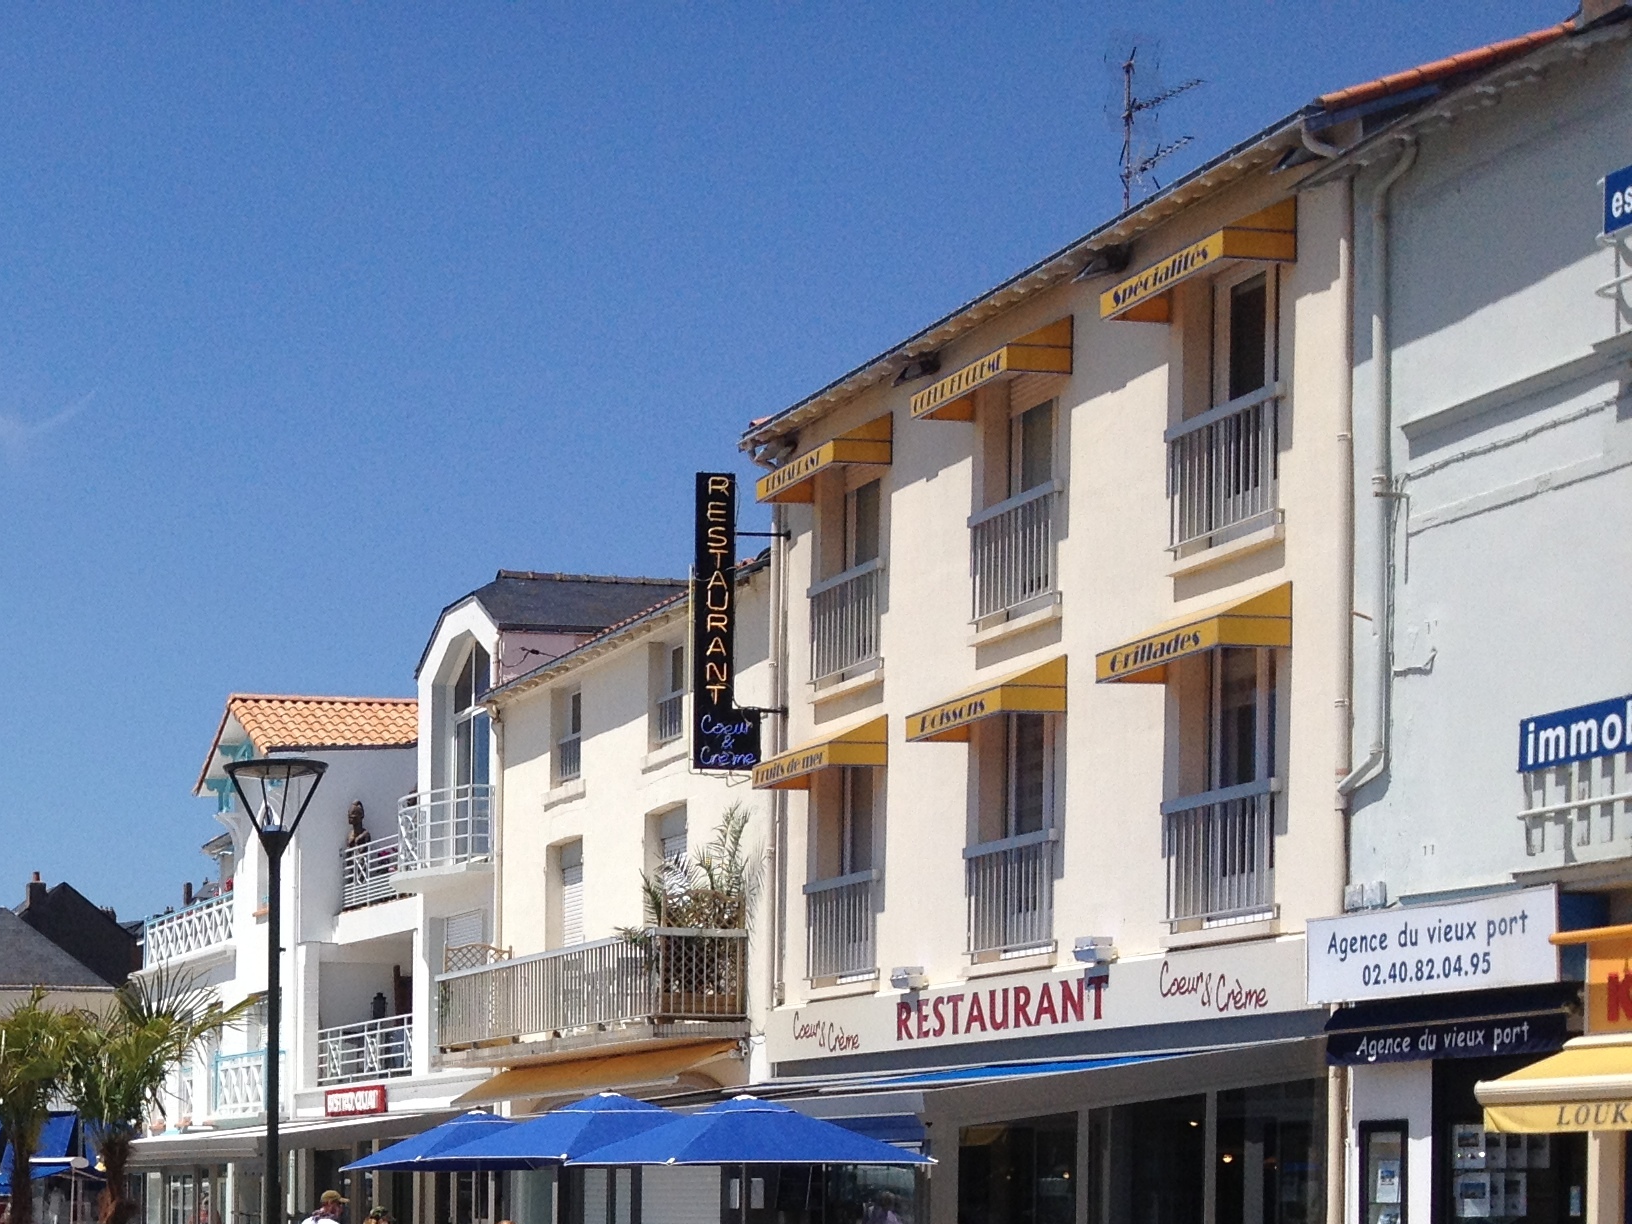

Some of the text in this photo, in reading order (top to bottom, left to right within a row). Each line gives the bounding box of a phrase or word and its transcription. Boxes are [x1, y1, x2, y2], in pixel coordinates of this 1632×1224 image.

[1112, 244, 1208, 308] Spécialités
[705, 476, 729, 705] RESTAURANT
[1110, 630, 1201, 673] Grillades
[700, 714, 753, 735] Coeur
[920, 698, 986, 733] Poissons
[721, 734, 735, 749] &
[786, 757, 801, 774] de
[801, 751, 826, 769] mer
[1326, 910, 1528, 963] Agence du vieux port
[1159, 960, 1268, 1013] Coeur & Crème
[1362, 951, 1492, 987] 02.40.82.04.95
[896, 975, 1109, 1042] RESTAURANT
[792, 1010, 820, 1040] Coeur
[827, 1022, 860, 1053] Crème
[1356, 1020, 1530, 1062] Agence du vieux port
[1556, 1102, 1632, 1126] LOUK
